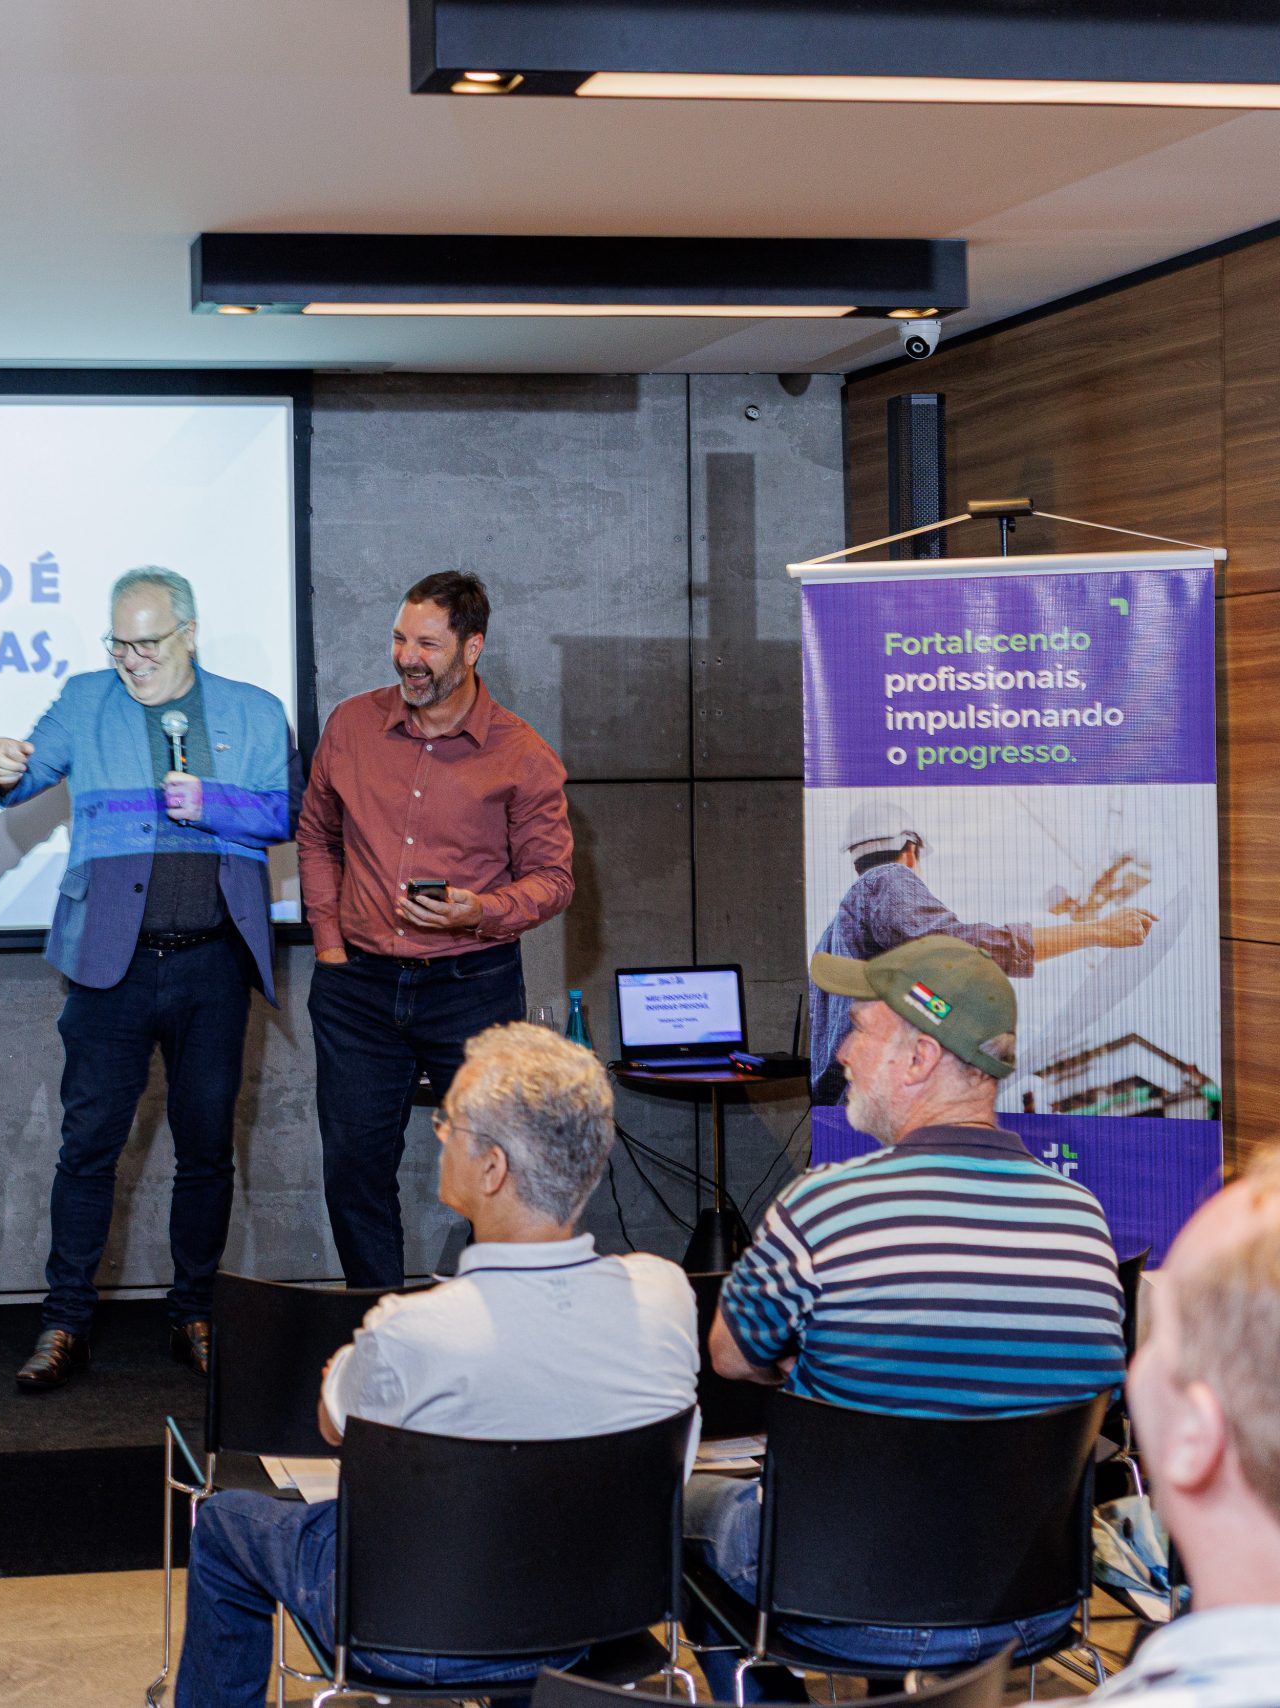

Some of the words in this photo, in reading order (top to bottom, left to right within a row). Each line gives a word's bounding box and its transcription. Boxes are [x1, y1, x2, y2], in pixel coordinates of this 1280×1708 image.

[30, 550, 61, 604] É
[885, 626, 1091, 656] Fortalecendo
[885, 663, 1087, 698] profissionais,
[885, 701, 1124, 735] impulsionando
[887, 746, 907, 765] o
[917, 743, 1078, 770] progresso.
